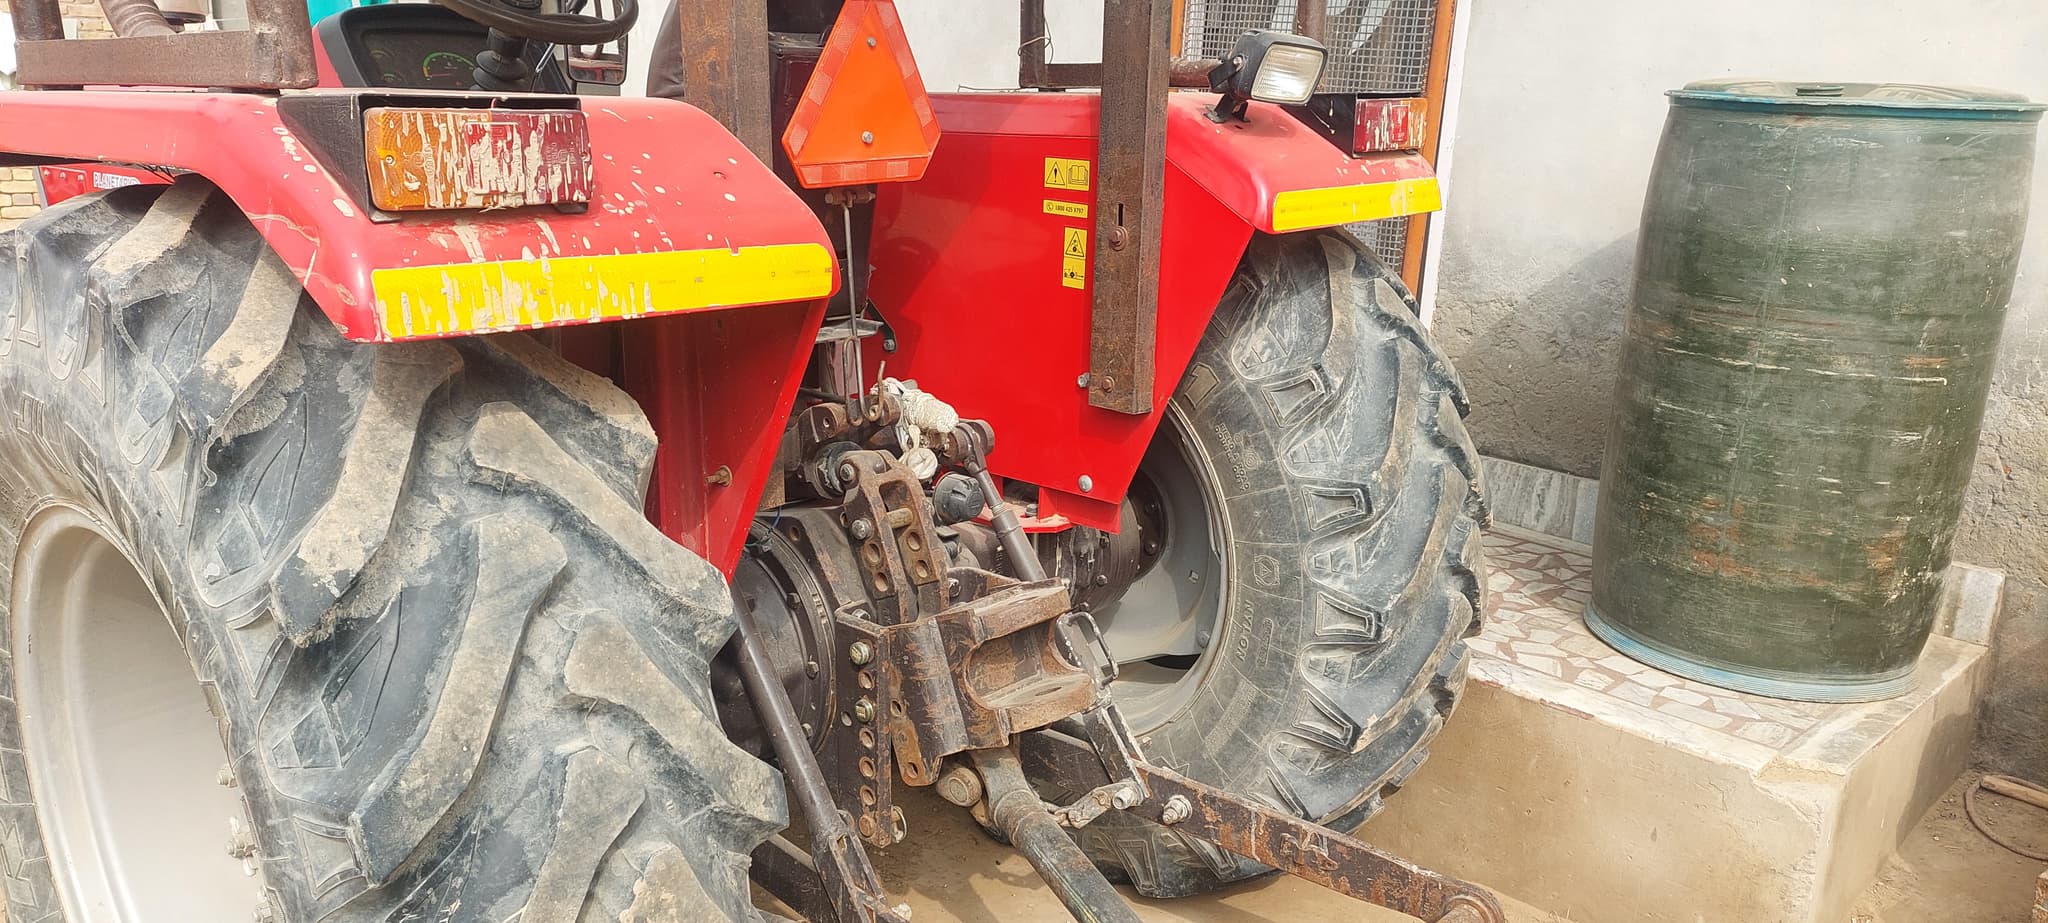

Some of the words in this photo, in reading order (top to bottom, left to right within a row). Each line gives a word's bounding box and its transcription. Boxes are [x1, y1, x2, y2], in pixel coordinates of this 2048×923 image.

[1220, 423, 1235, 450] FIELD
[1236, 461, 1250, 491] ROAD
[1235, 599, 1254, 662] NYLON
